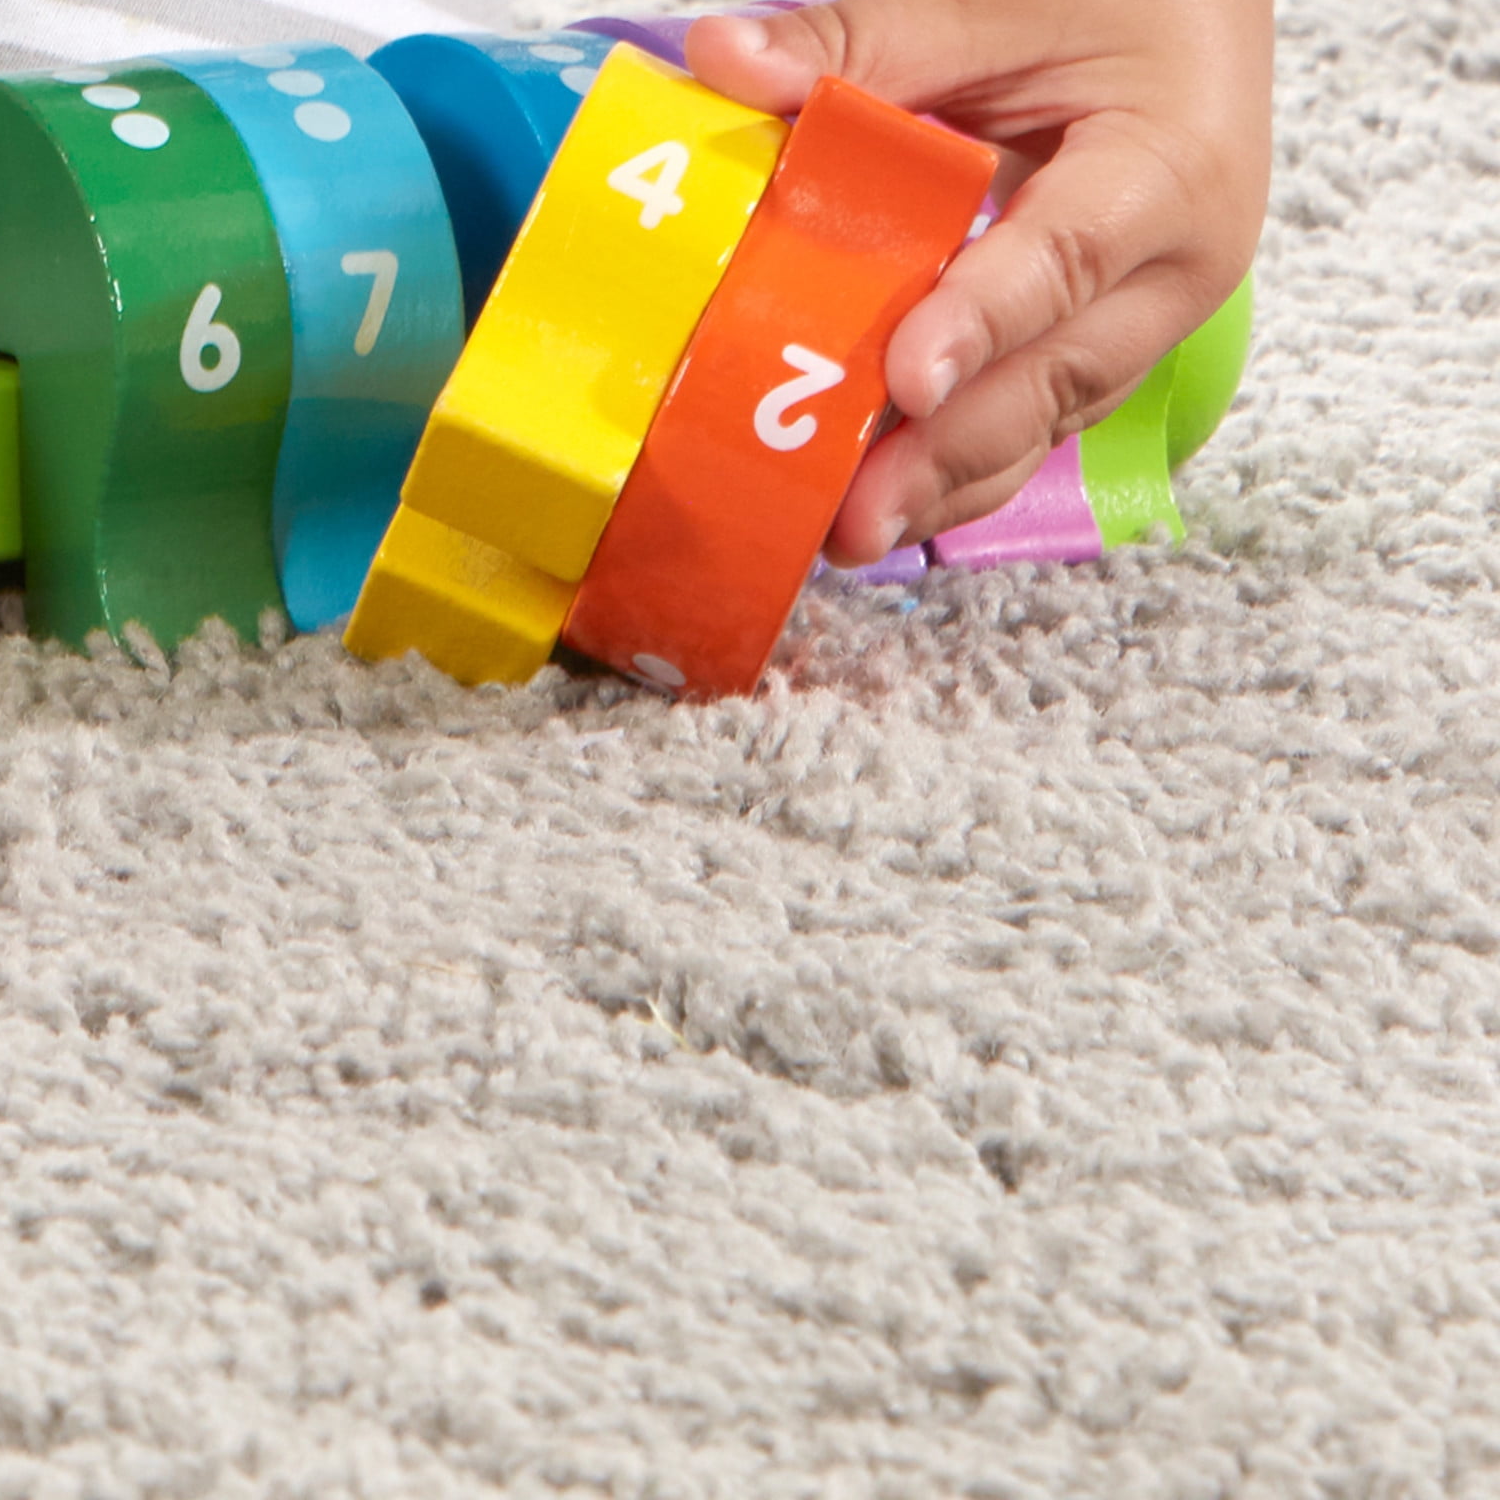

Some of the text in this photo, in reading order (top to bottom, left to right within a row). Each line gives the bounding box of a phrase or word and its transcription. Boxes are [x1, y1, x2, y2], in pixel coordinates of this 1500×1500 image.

[607, 140, 690, 229] 4
[180, 284, 241, 389] 6
[340, 250, 398, 356] 7
[753, 343, 846, 452] 2
